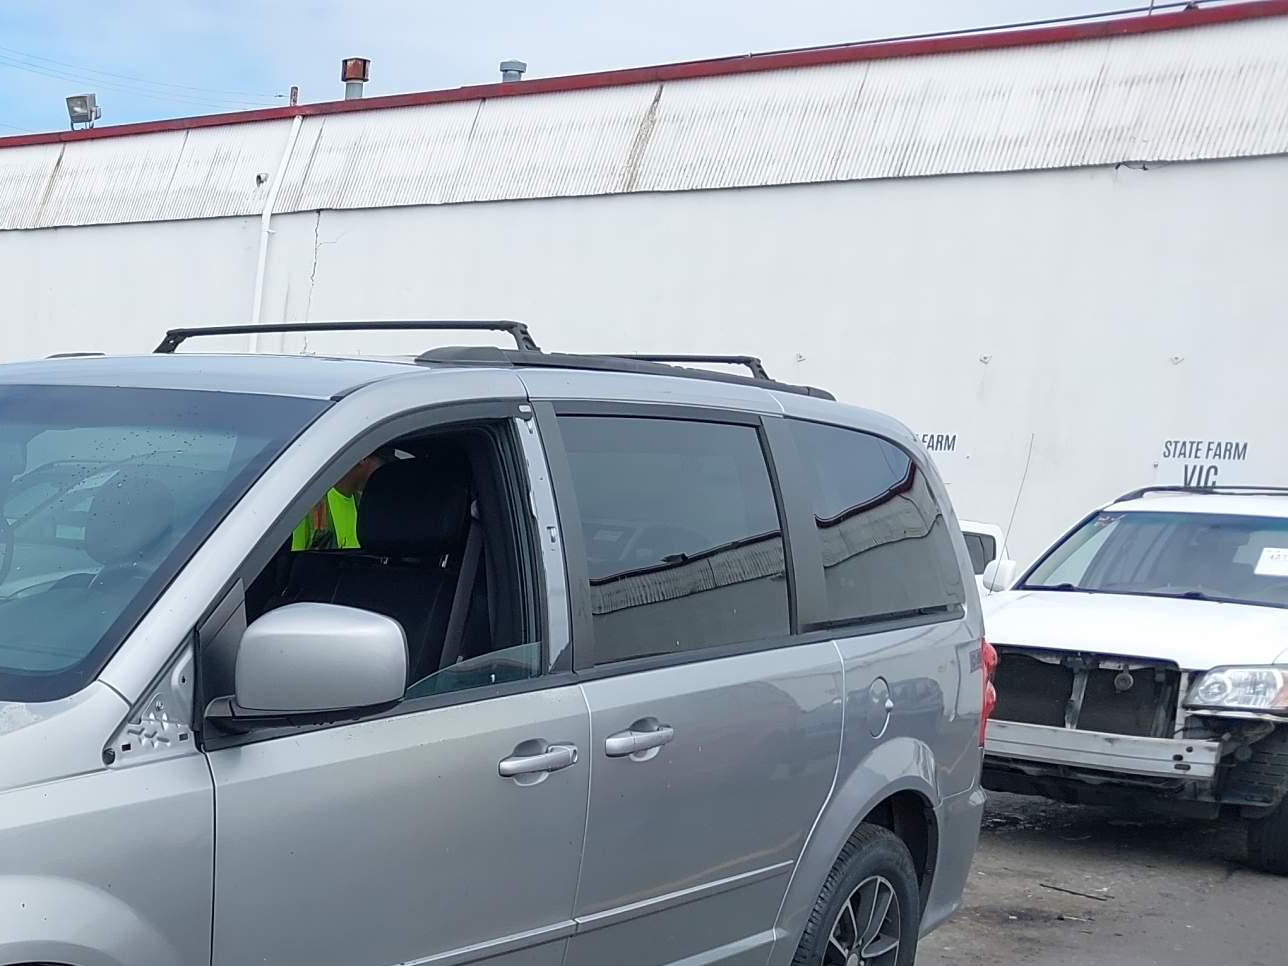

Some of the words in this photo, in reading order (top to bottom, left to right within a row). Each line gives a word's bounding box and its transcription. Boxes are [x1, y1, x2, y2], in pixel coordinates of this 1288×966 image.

[1162, 440, 1204, 459] STATE
[1205, 441, 1248, 460] FARM
[1183, 464, 1218, 488] VIC
